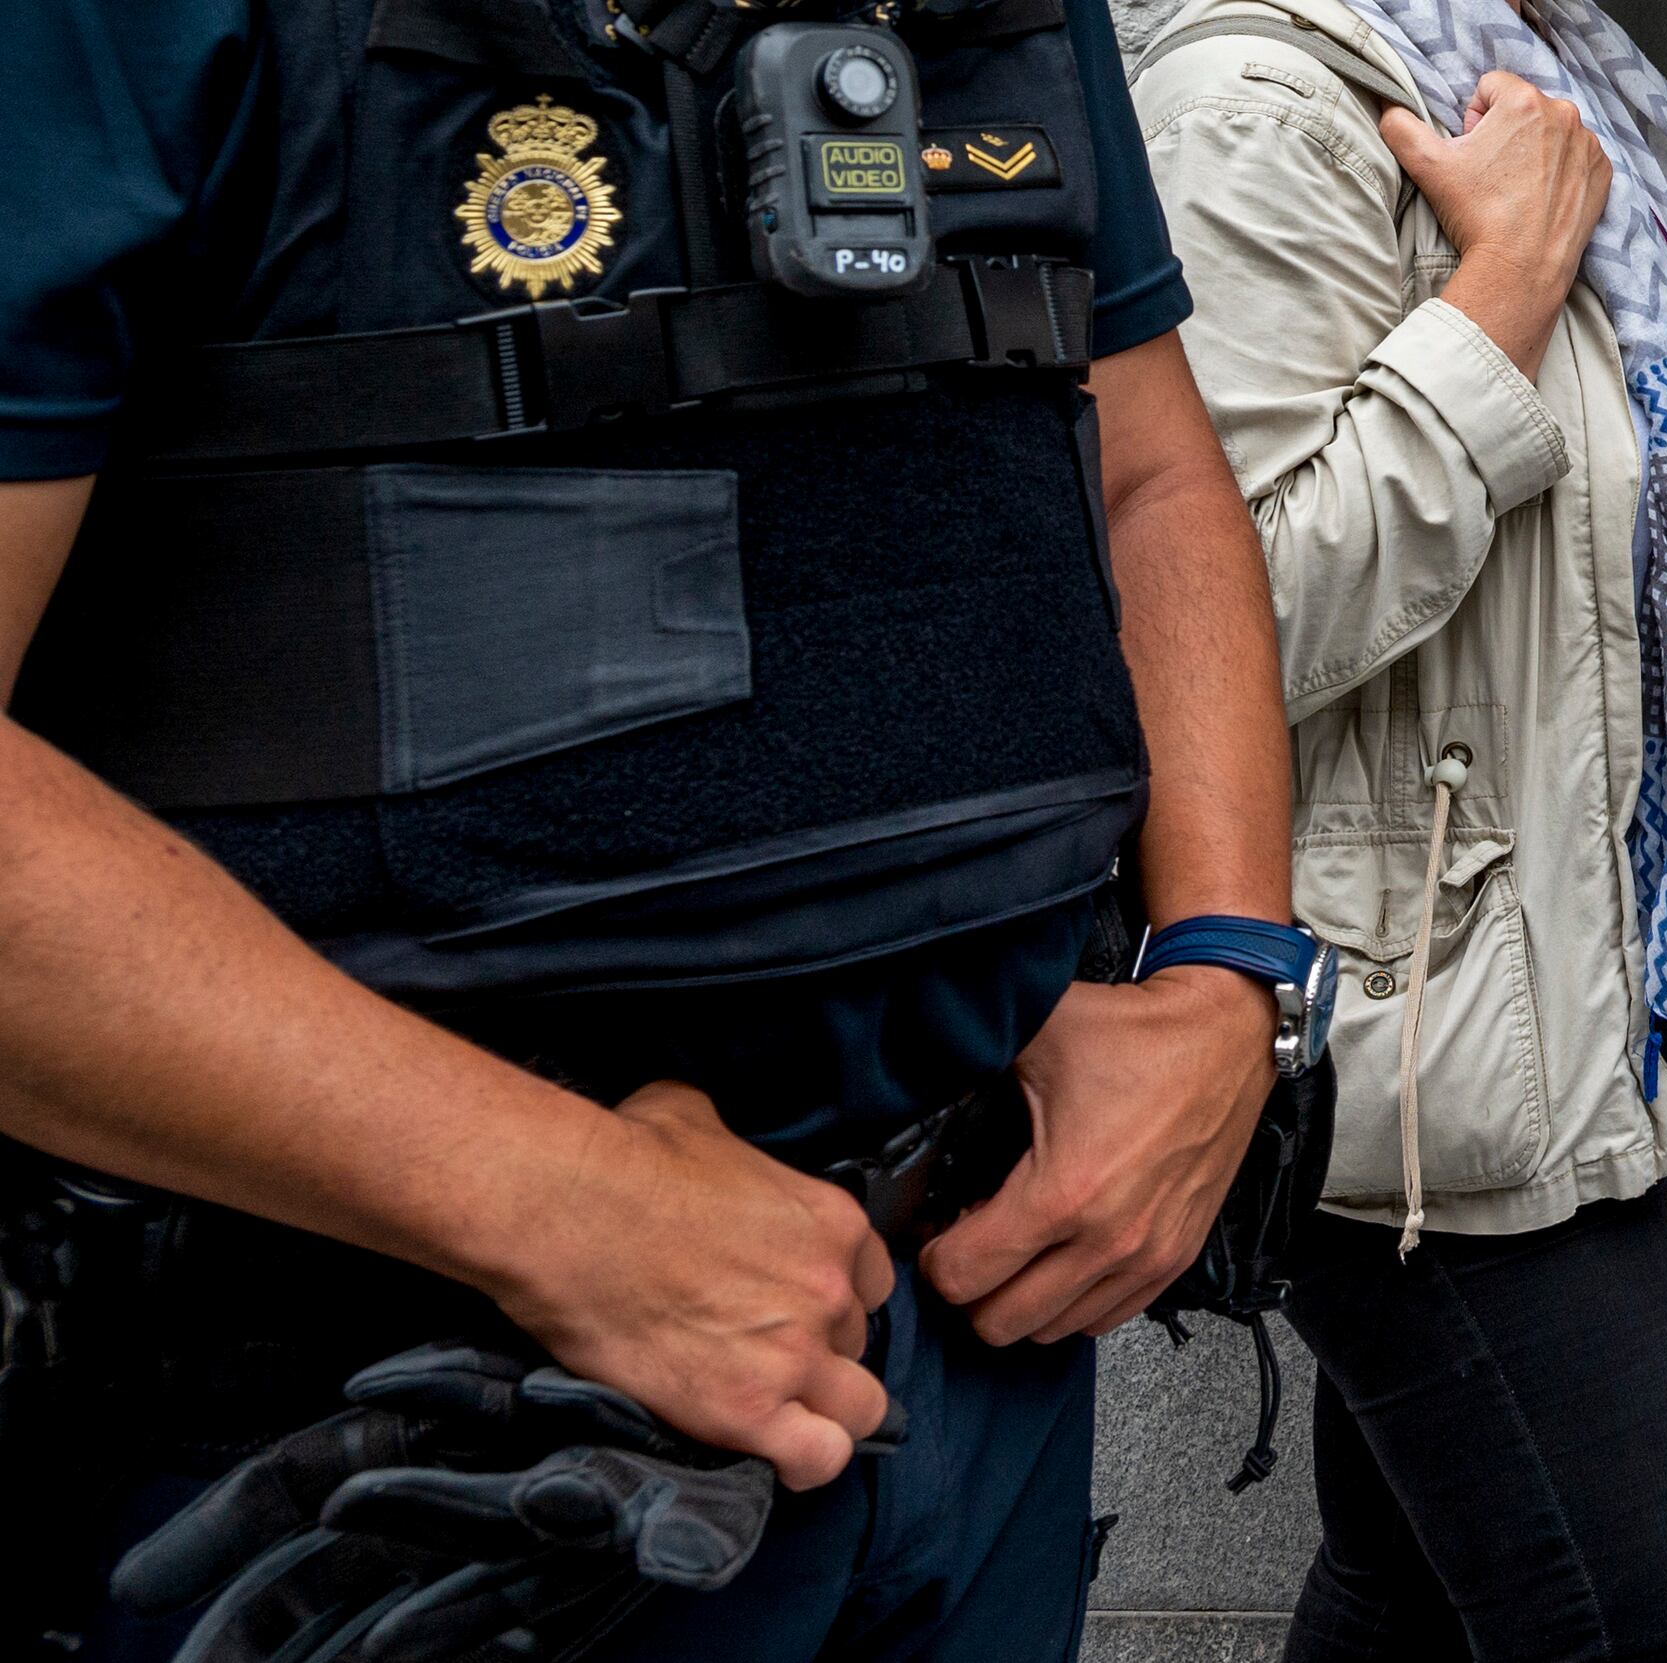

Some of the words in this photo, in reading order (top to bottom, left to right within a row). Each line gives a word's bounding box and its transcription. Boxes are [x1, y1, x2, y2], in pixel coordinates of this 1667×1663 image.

[830, 147, 896, 164] AUDIO
[831, 170, 898, 186] VIDEO
[835, 248, 907, 273] P-40
